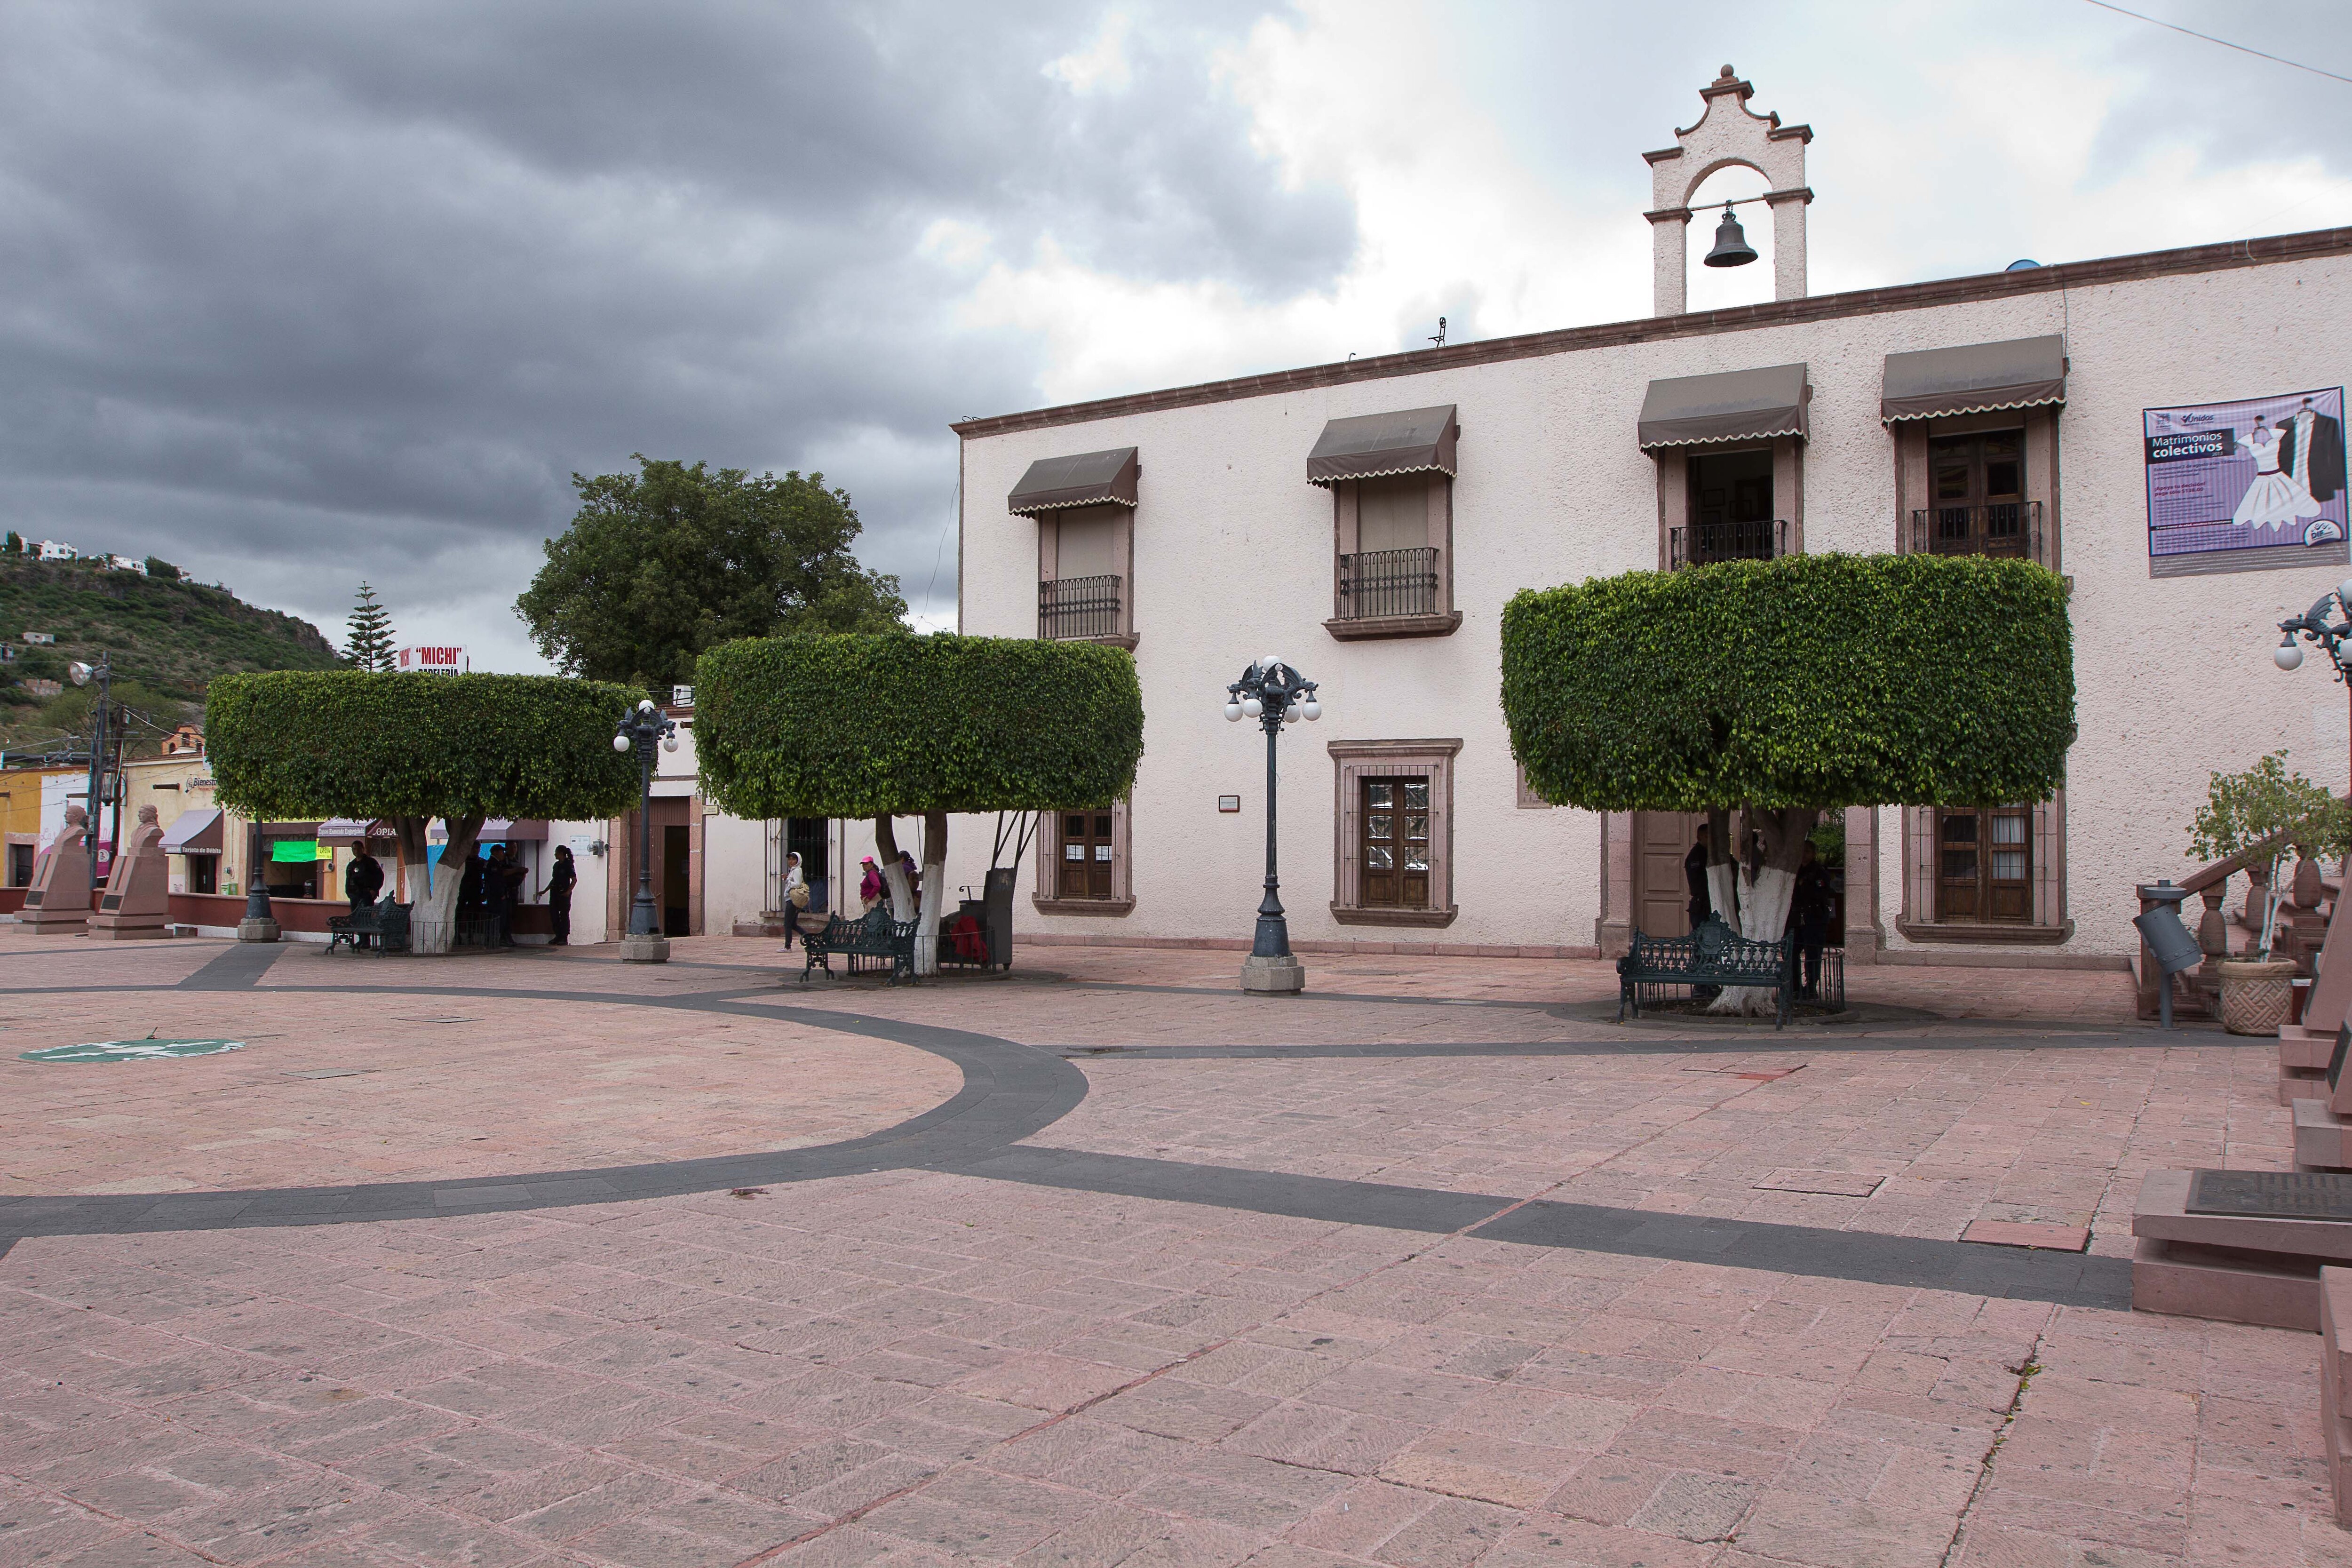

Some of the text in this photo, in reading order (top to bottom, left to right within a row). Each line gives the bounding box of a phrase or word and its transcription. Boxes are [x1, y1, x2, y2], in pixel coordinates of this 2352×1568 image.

[2187, 414, 2214, 423] Unidos
[2153, 432, 2222, 447] Matrimonios
[2153, 442, 2223, 458] colectivos
[372, 828, 399, 836] OPIA
